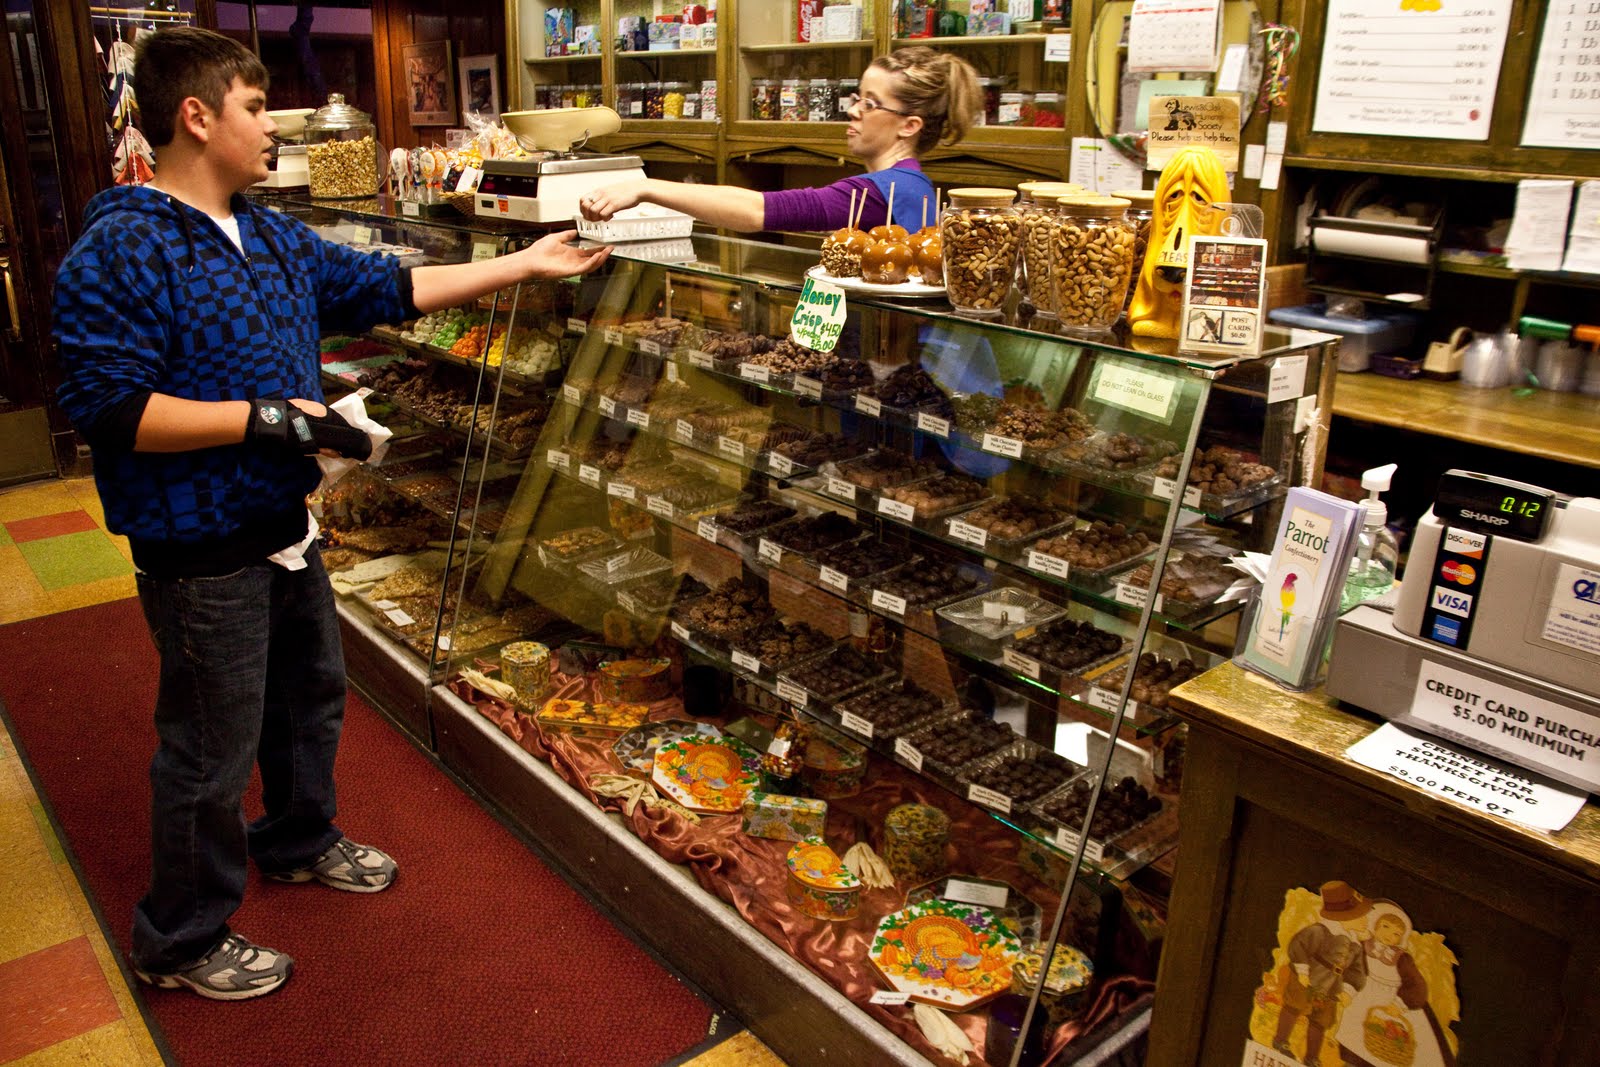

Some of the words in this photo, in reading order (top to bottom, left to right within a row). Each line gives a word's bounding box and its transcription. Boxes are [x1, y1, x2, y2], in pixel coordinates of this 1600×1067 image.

[1198, 121, 1223, 131] Society
[1151, 132, 1175, 141] Please
[1177, 132, 1192, 144] help
[1204, 132, 1218, 145] help
[800, 278, 842, 316] Honey
[792, 304, 822, 334] Crisp
[1231, 316, 1249, 324] POST
[1228, 324, 1251, 332] CARDS
[1102, 380, 1111, 388] DO
[1111, 382, 1123, 391] NOT
[1123, 386, 1137, 395] LEAN
[1146, 392, 1164, 402] GLASS
[1126, 378, 1144, 389] PLEASE
[999, 438, 1017, 448] Chocolate
[1304, 520, 1316, 529] The
[1459, 509, 1509, 526] SHARP
[955, 528, 967, 536] Coffee
[964, 525, 982, 536] Chocolate
[1284, 520, 1330, 553] Parrot
[1447, 533, 1484, 549] DISCOVER
[1044, 557, 1063, 567] Chocolate
[1285, 544, 1319, 566] Confectionery
[1034, 560, 1048, 568] Vanilla
[1132, 588, 1148, 597] Chocol
[1437, 592, 1468, 612] VISA
[1426, 679, 1481, 706] CREDIT
[1485, 700, 1529, 723] CARD
[1535, 716, 1600, 749] PURCHA
[1453, 705, 1497, 729] $5.00
[1501, 722, 1586, 761] MINIMUM
[1411, 747, 1485, 776] SORBET
[1492, 777, 1534, 795] FOR
[1422, 742, 1536, 786] CRANBERRY
[1396, 750, 1538, 805] THANKSGIVING
[1388, 765, 1437, 787] $9.00
[1441, 785, 1482, 804] PER
[1486, 802, 1514, 815] QT
[708, 1014, 720, 1035] ALSCO
